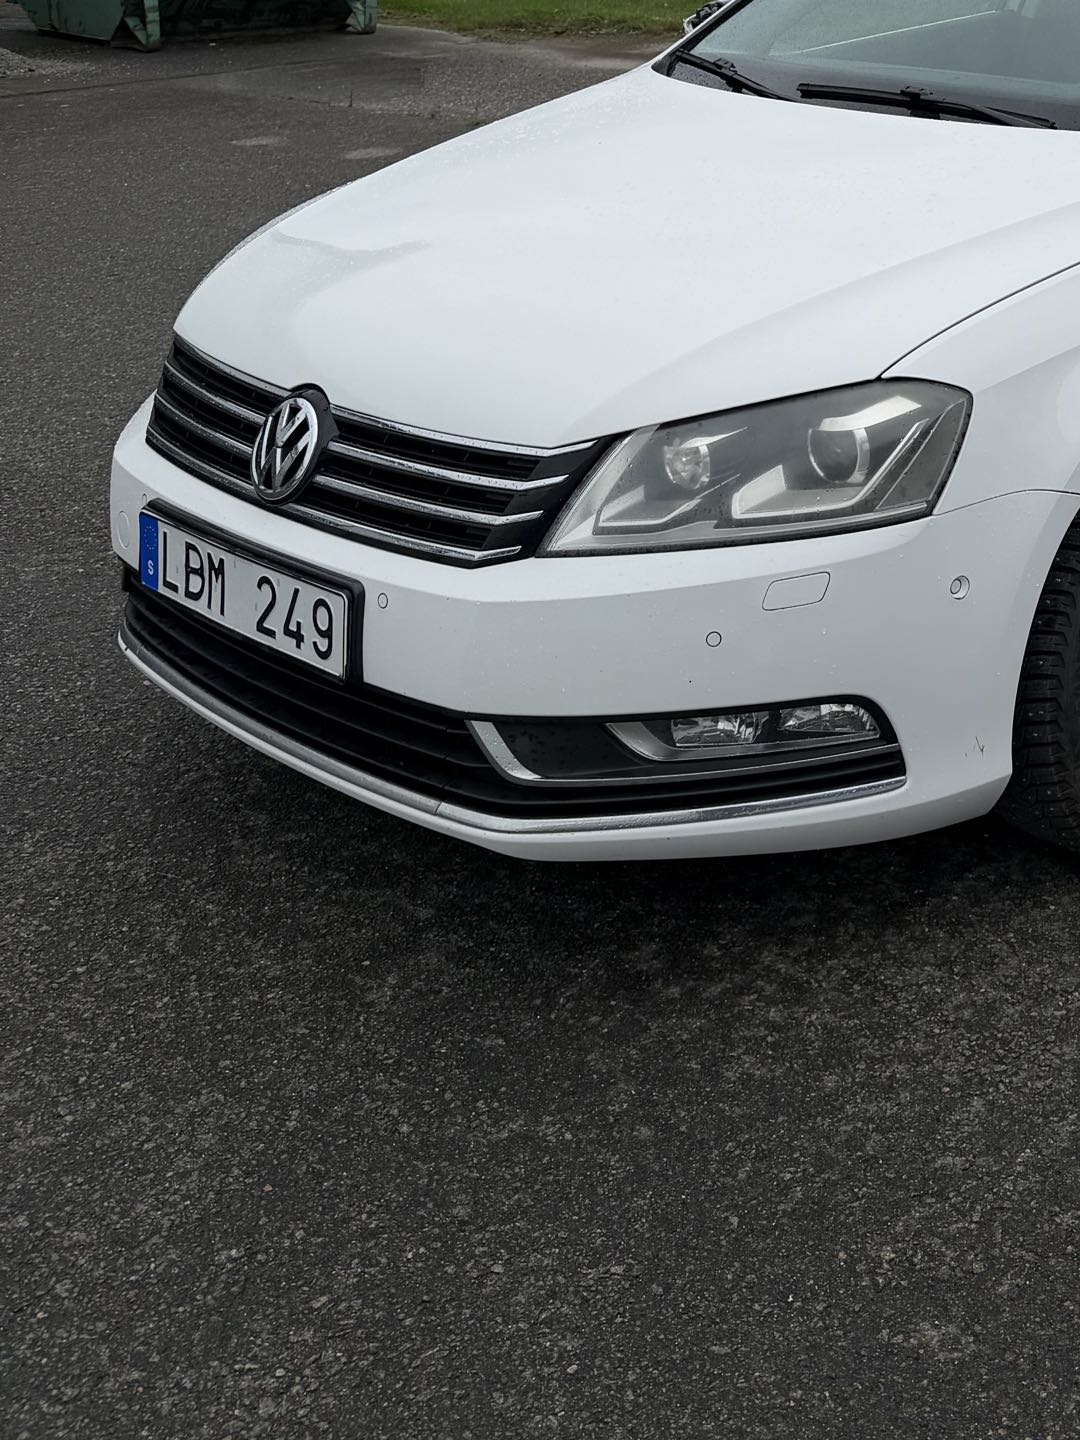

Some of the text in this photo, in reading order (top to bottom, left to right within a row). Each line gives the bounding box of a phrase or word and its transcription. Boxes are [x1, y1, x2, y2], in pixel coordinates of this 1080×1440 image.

[147, 559, 155, 576] S
[162, 531, 333, 660] LBM 249
